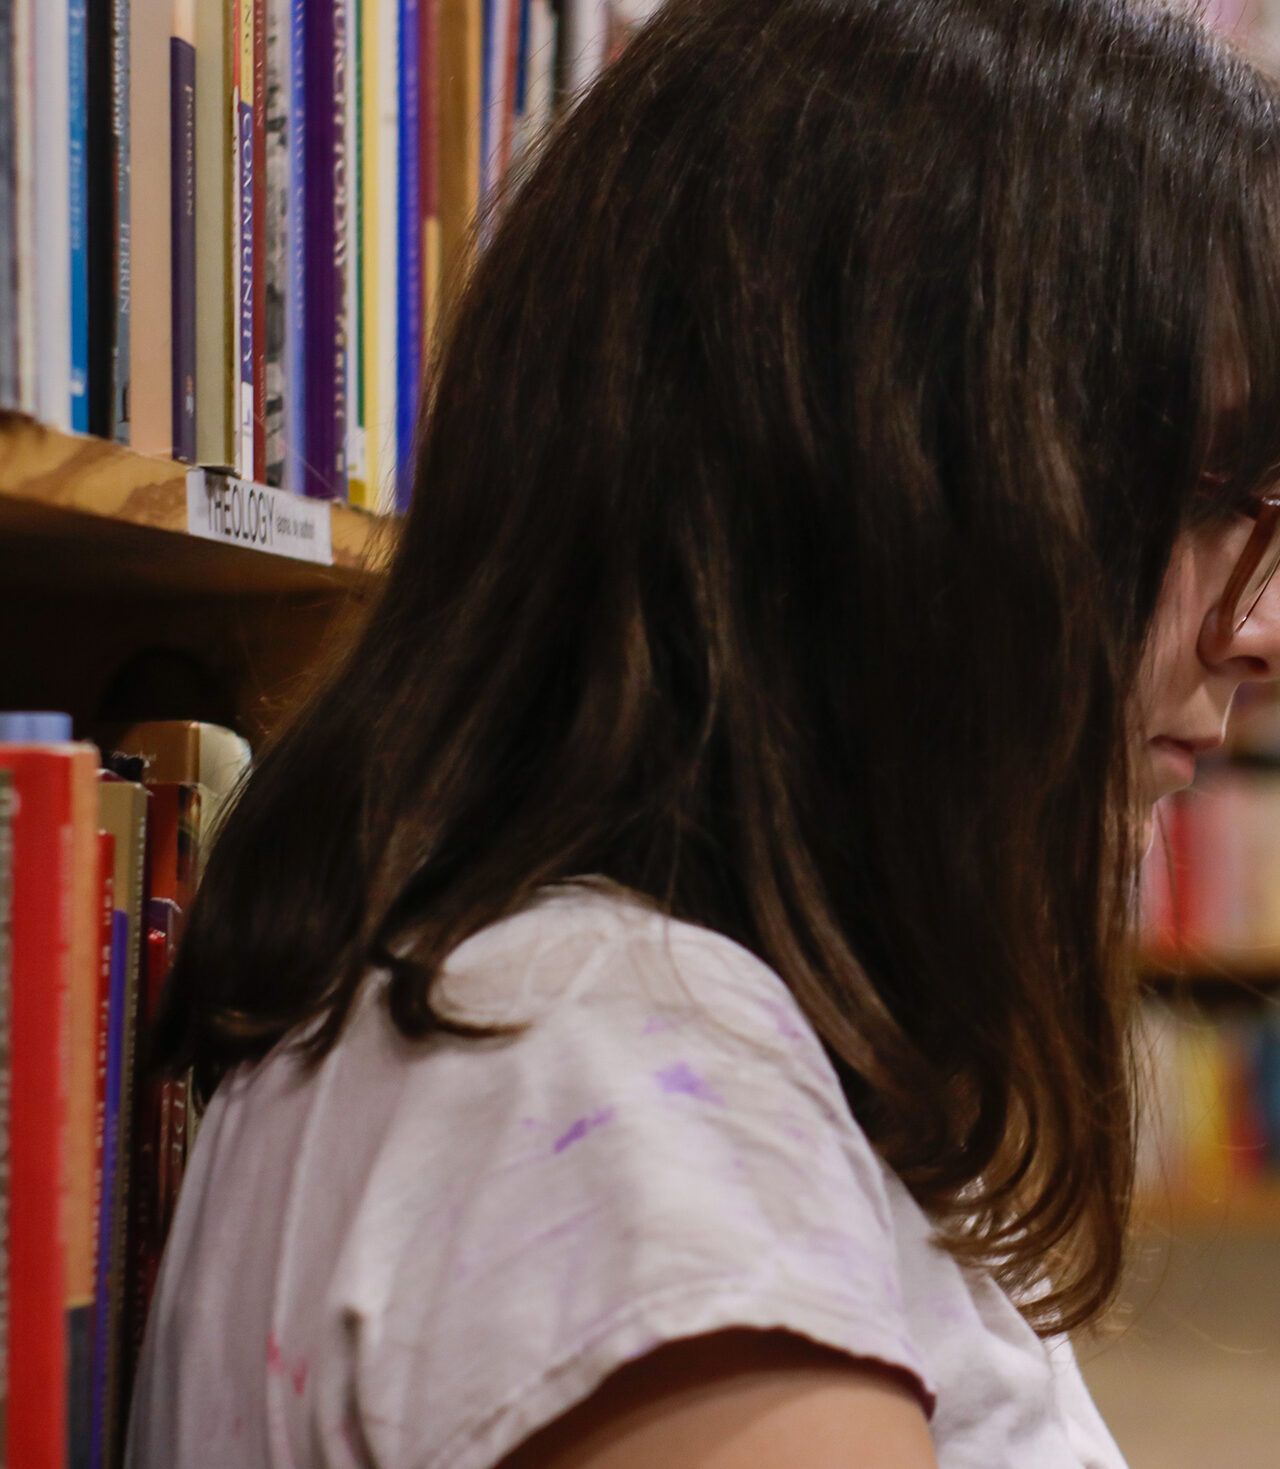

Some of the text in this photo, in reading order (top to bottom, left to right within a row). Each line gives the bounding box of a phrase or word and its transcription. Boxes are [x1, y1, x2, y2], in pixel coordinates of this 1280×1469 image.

[120, 222, 131, 315] PERRIN
[242, 111, 253, 369] COMMUNITY
[206, 481, 275, 546] THEOLOGY
